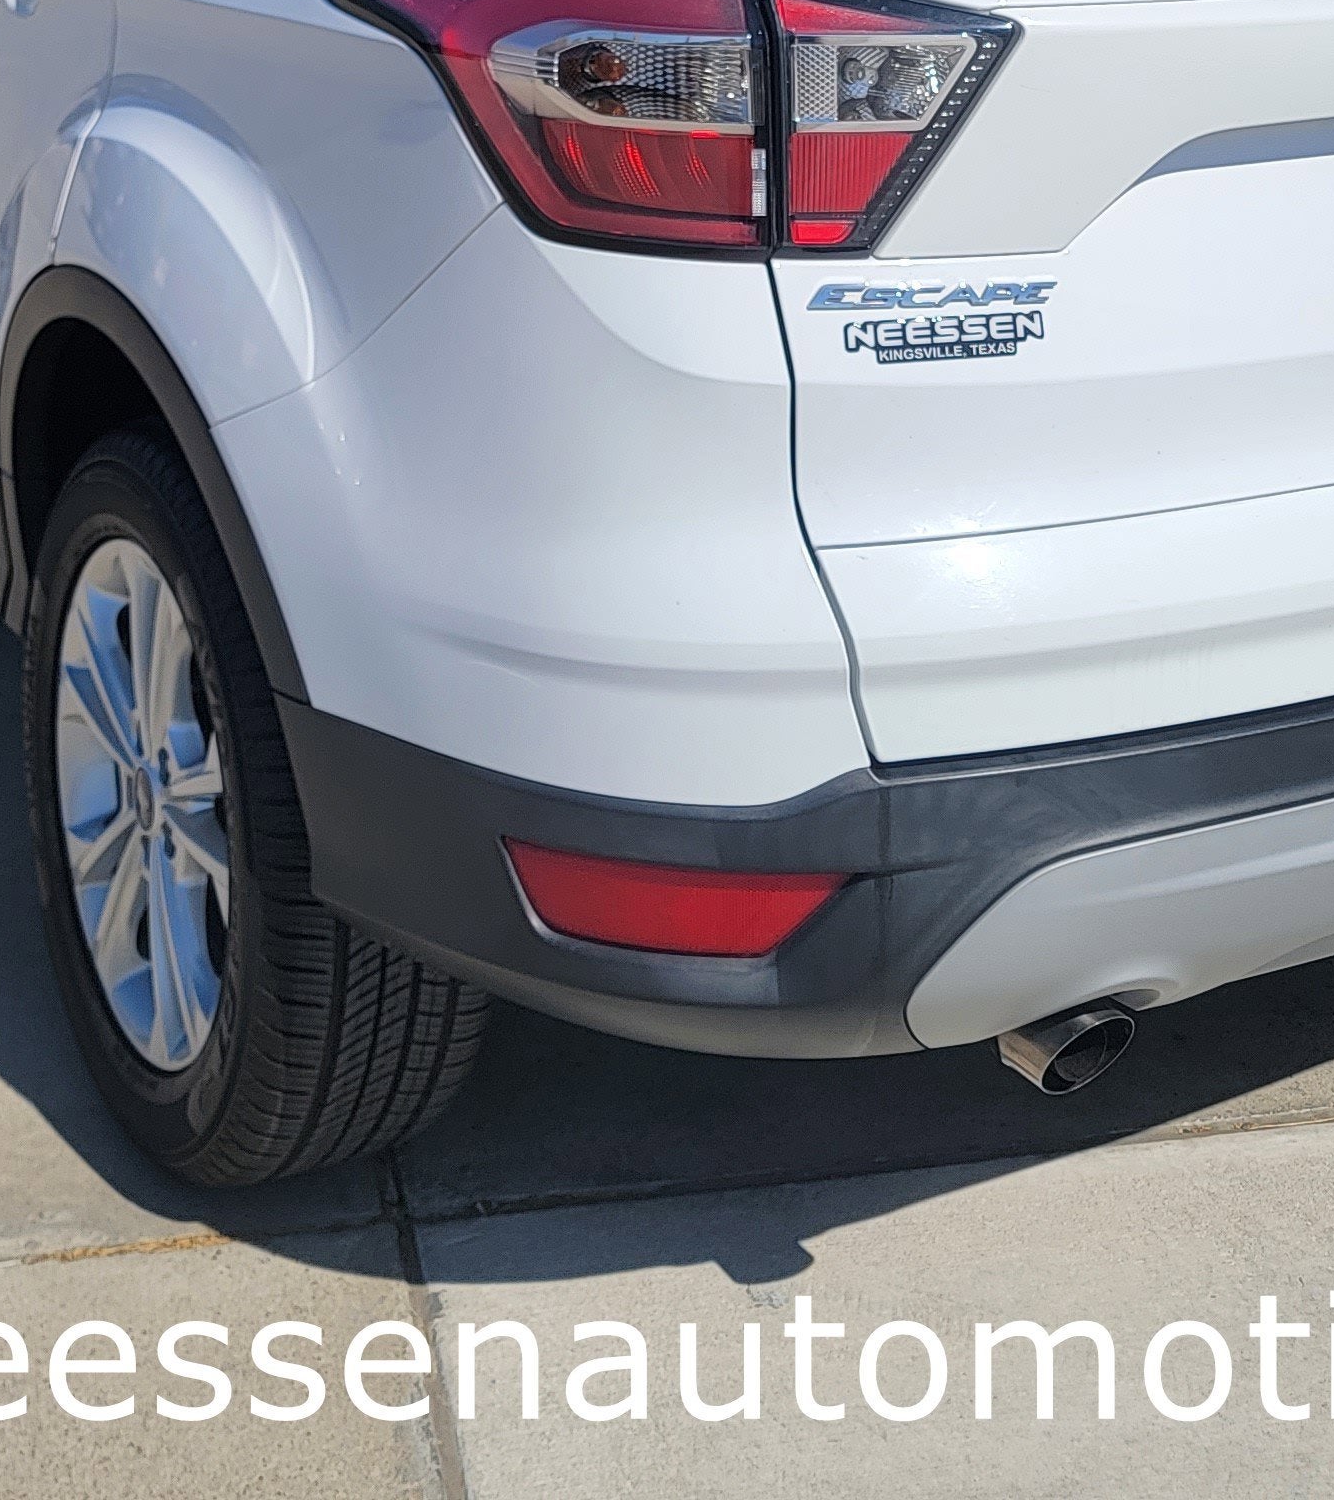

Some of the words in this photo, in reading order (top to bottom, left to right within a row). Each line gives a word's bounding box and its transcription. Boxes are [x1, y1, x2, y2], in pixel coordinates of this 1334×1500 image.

[806, 280, 1058, 311] ESCAPE
[846, 311, 1043, 350] NEESSEN
[877, 347, 967, 362] KINGSVILLE,
[969, 341, 1016, 356] TEXAS
